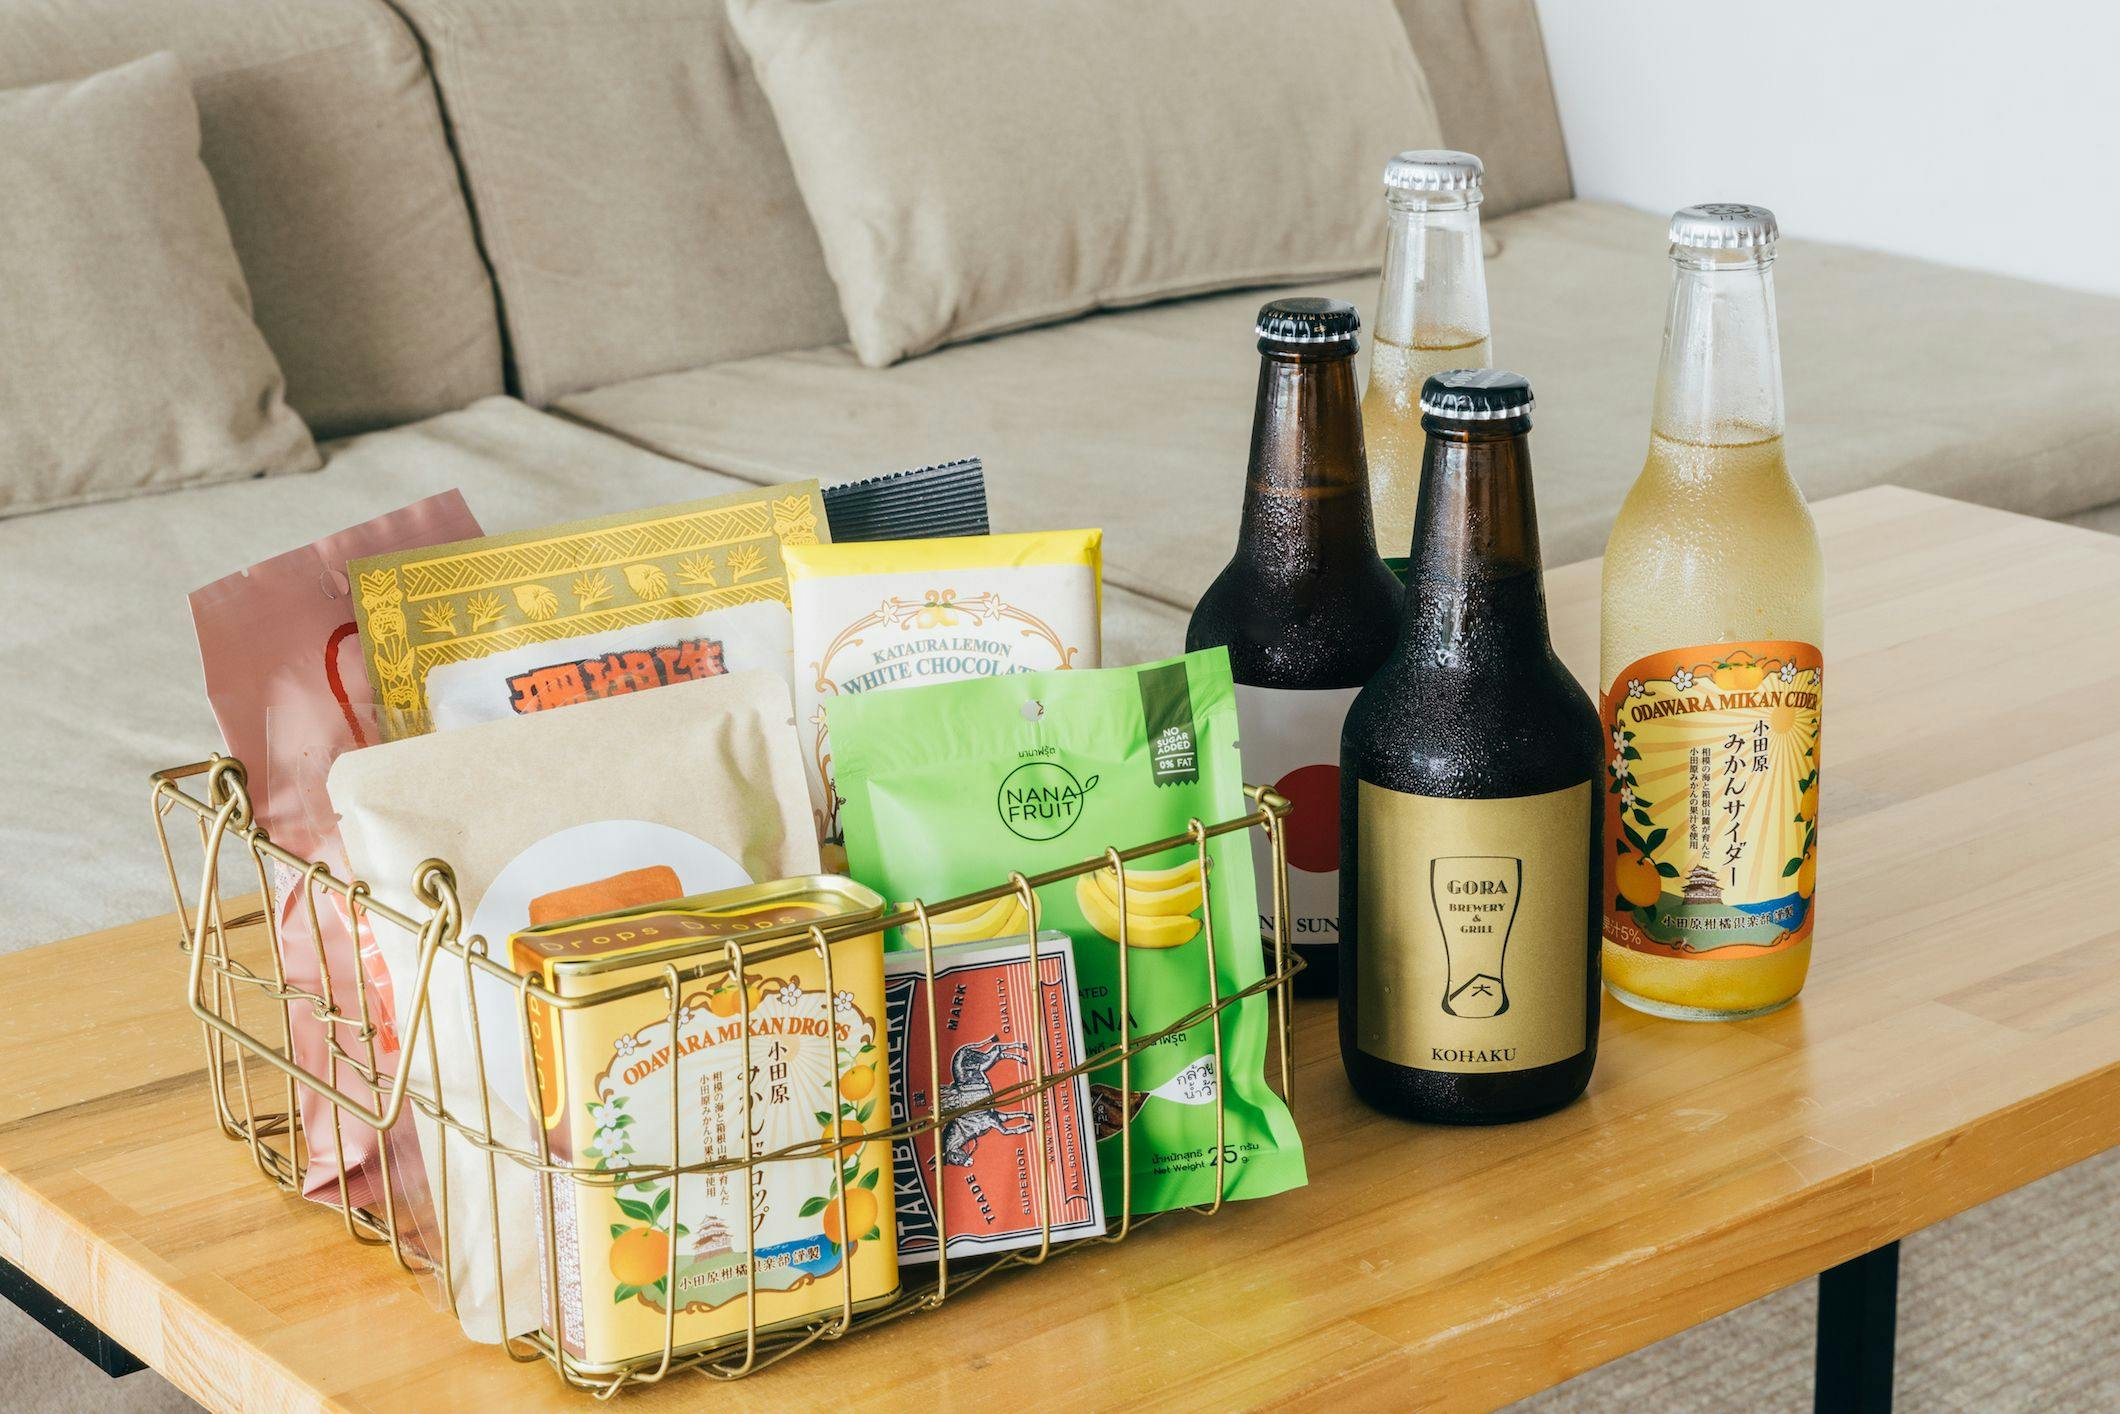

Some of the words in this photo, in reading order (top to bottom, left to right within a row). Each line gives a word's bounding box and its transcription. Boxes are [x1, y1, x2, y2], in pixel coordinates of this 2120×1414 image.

[872, 638, 951, 665] KATAURA
[952, 637, 1012, 658] LEMON
[841, 661, 912, 695] WHITE
[916, 656, 1037, 676] CHOCOLA
[1631, 696, 1715, 723] ODAWARA
[1718, 691, 1783, 710] MIKAN
[1785, 690, 1818, 711] CIDER
[1157, 732, 1188, 748] SUGAR
[1163, 727, 1179, 737] NO
[1158, 740, 1190, 755] ADDED
[1752, 720, 1769, 773] 小田原
[1159, 759, 1175, 769] 0%
[1176, 757, 1192, 768] FAT
[1007, 785, 1077, 805] NANA
[1689, 747, 1699, 850] 小田原みかんの果汁を使用
[1008, 801, 1073, 823] FRUIT
[1723, 733, 1747, 887] みかんサイダー
[1447, 880, 1508, 895] GORA
[1449, 903, 1505, 913] BREWERY
[1472, 914, 1482, 923] &
[540, 926, 659, 951] Drops
[680, 915, 796, 932] Drops
[1460, 925, 1494, 934] GRILL
[946, 983, 967, 1031] MARK
[996, 977, 1010, 1033] QUALITY
[1050, 988, 1061, 1029] BREAD.
[531, 978, 545, 1090] Drop
[1054, 1033, 1064, 1060] WITH
[623, 1031, 716, 1085] ODAWARA
[717, 1016, 785, 1045] MIKAN
[1431, 1048, 1517, 1063] KOHAKU
[768, 1041, 790, 1105] 小田原
[1057, 1062, 1068, 1088] LSS
[1060, 1089, 1070, 1113] ARE
[1063, 1116, 1076, 1169] SORROWS
[1016, 1147, 1031, 1216] SUPERIOR
[1070, 1171, 1080, 1192] ALL
[1153, 1166, 1171, 1175] Net
[1172, 1161, 1205, 1172] Weight
[891, 1138, 933, 1237] TAKIB
[965, 1172, 996, 1225] TRADE
